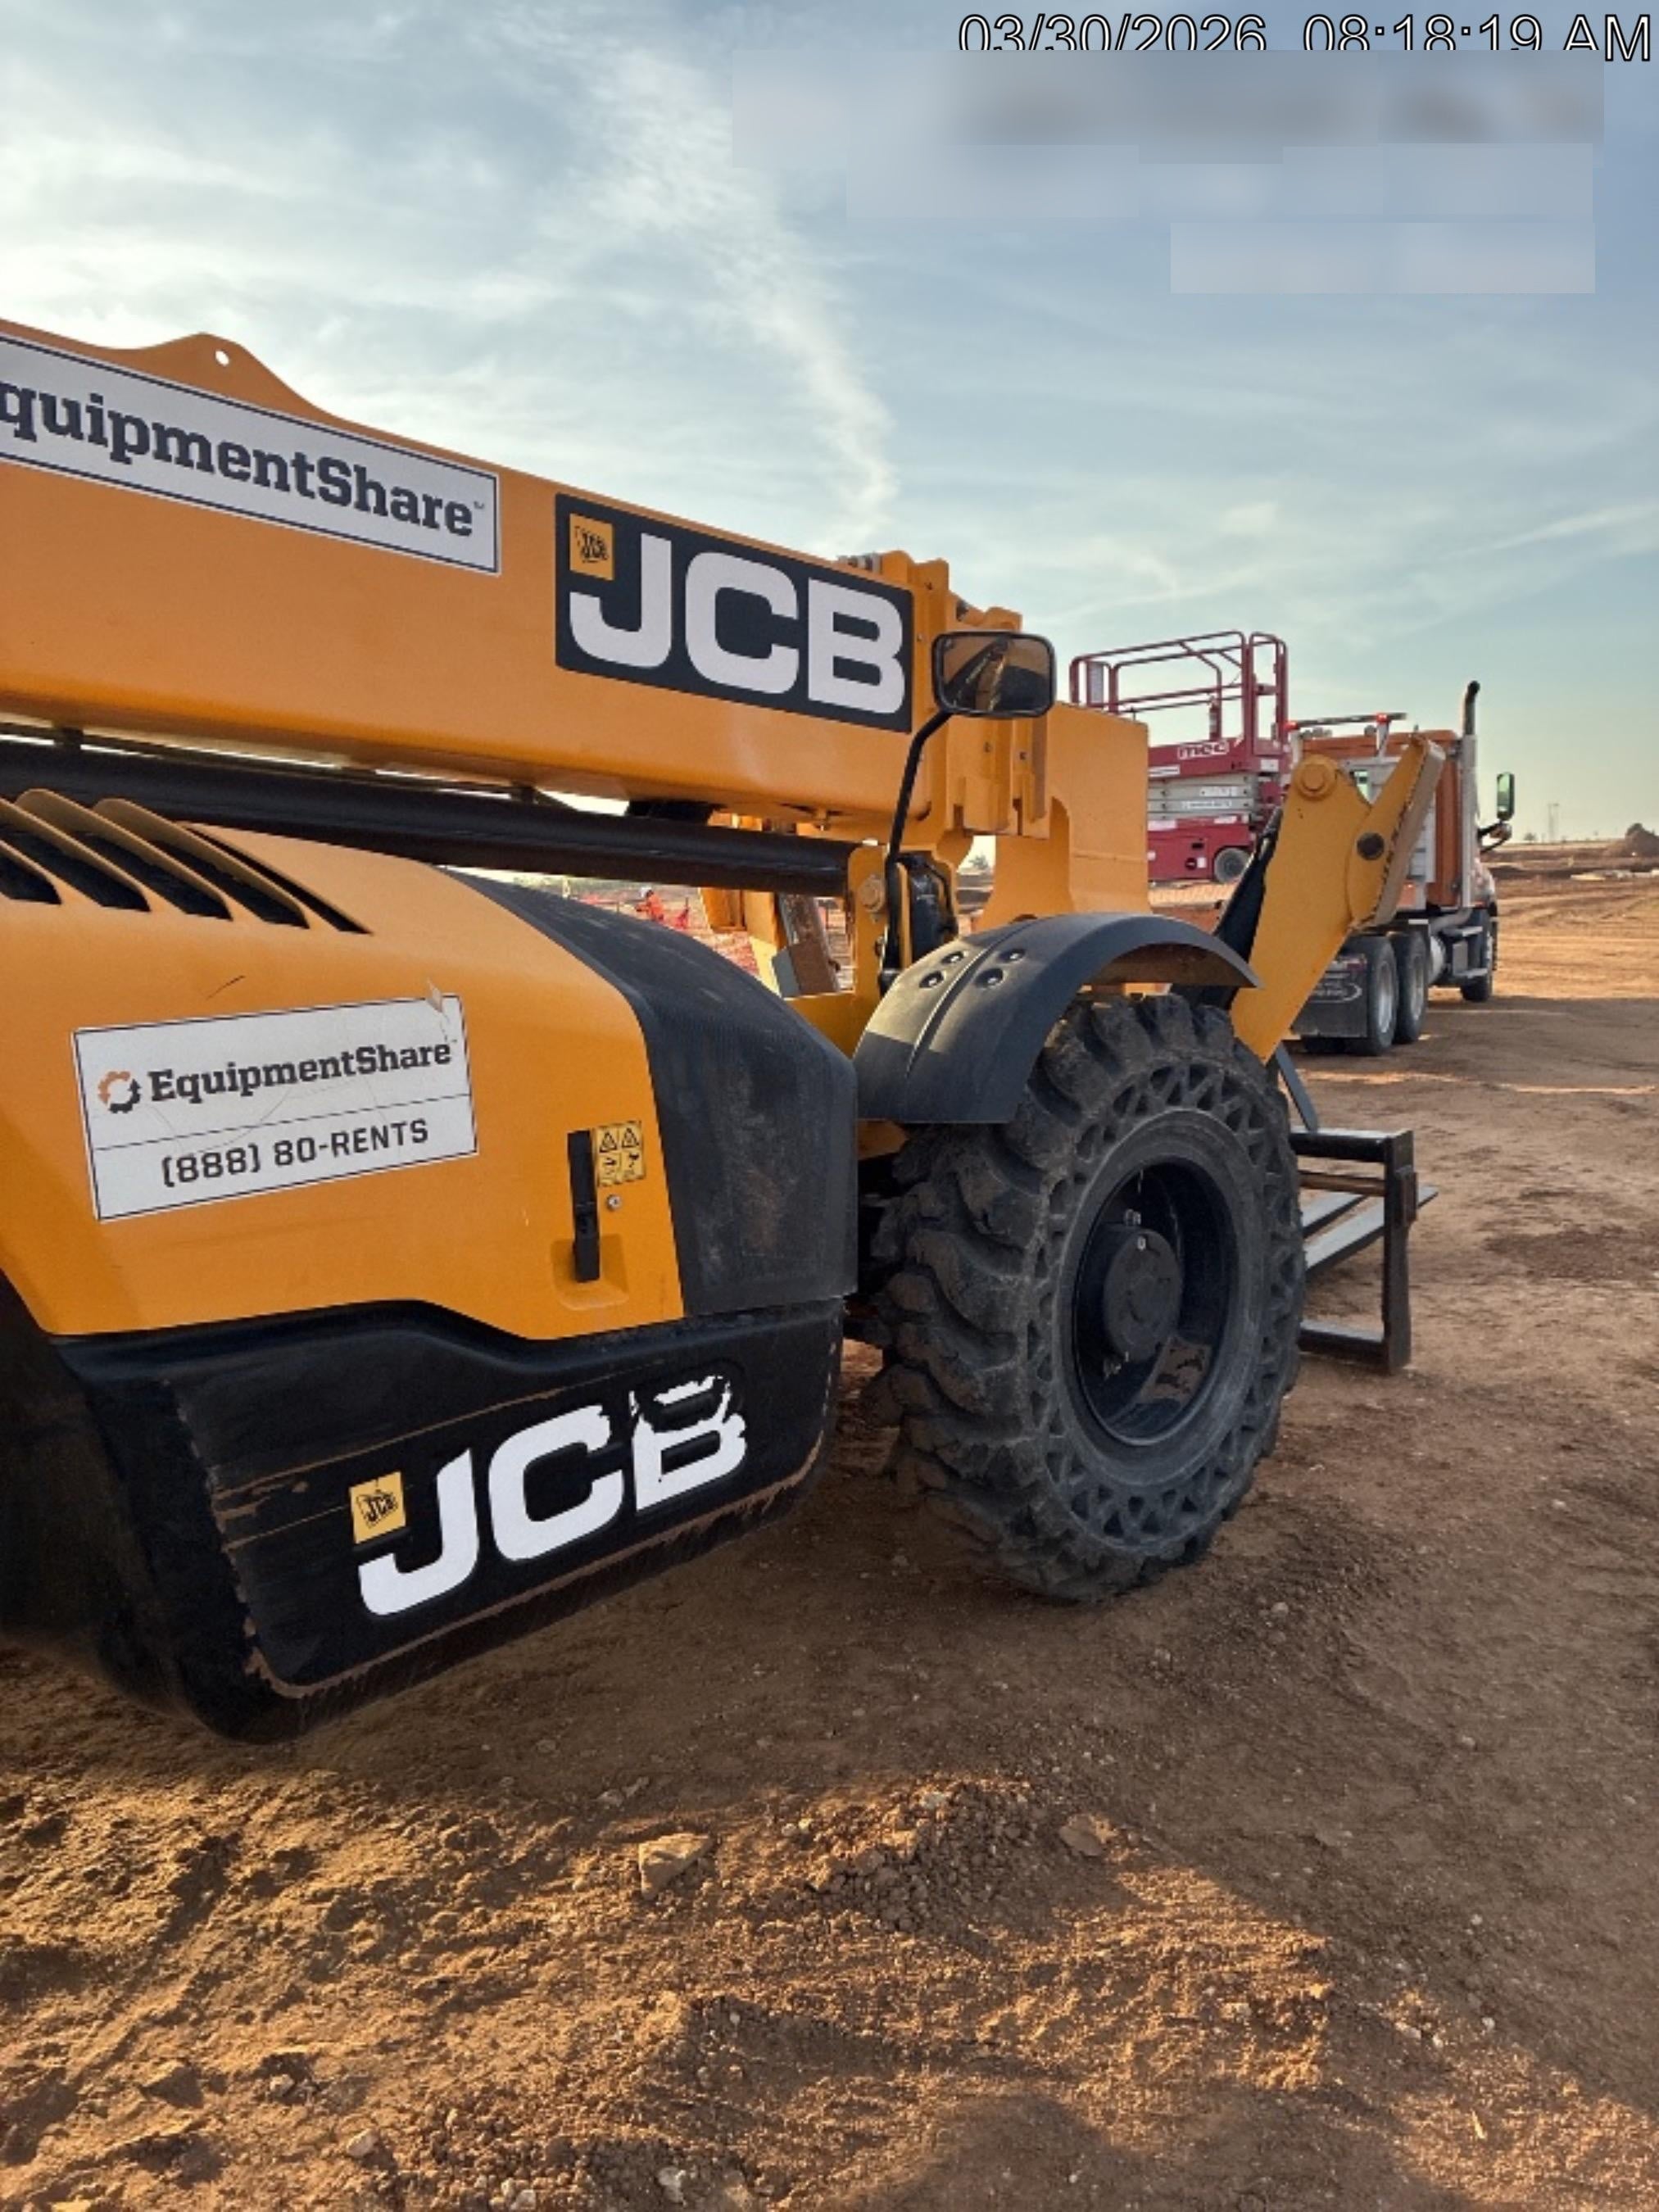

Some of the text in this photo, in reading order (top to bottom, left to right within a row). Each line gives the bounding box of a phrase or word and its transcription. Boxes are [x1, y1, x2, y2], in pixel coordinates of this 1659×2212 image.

[569, 533, 905, 714] JCB
[148, 1044, 451, 1104] EquipmentShare
[161, 1118, 429, 1188] (888) 80-RENTS
[358, 1376, 747, 1616] JCB
